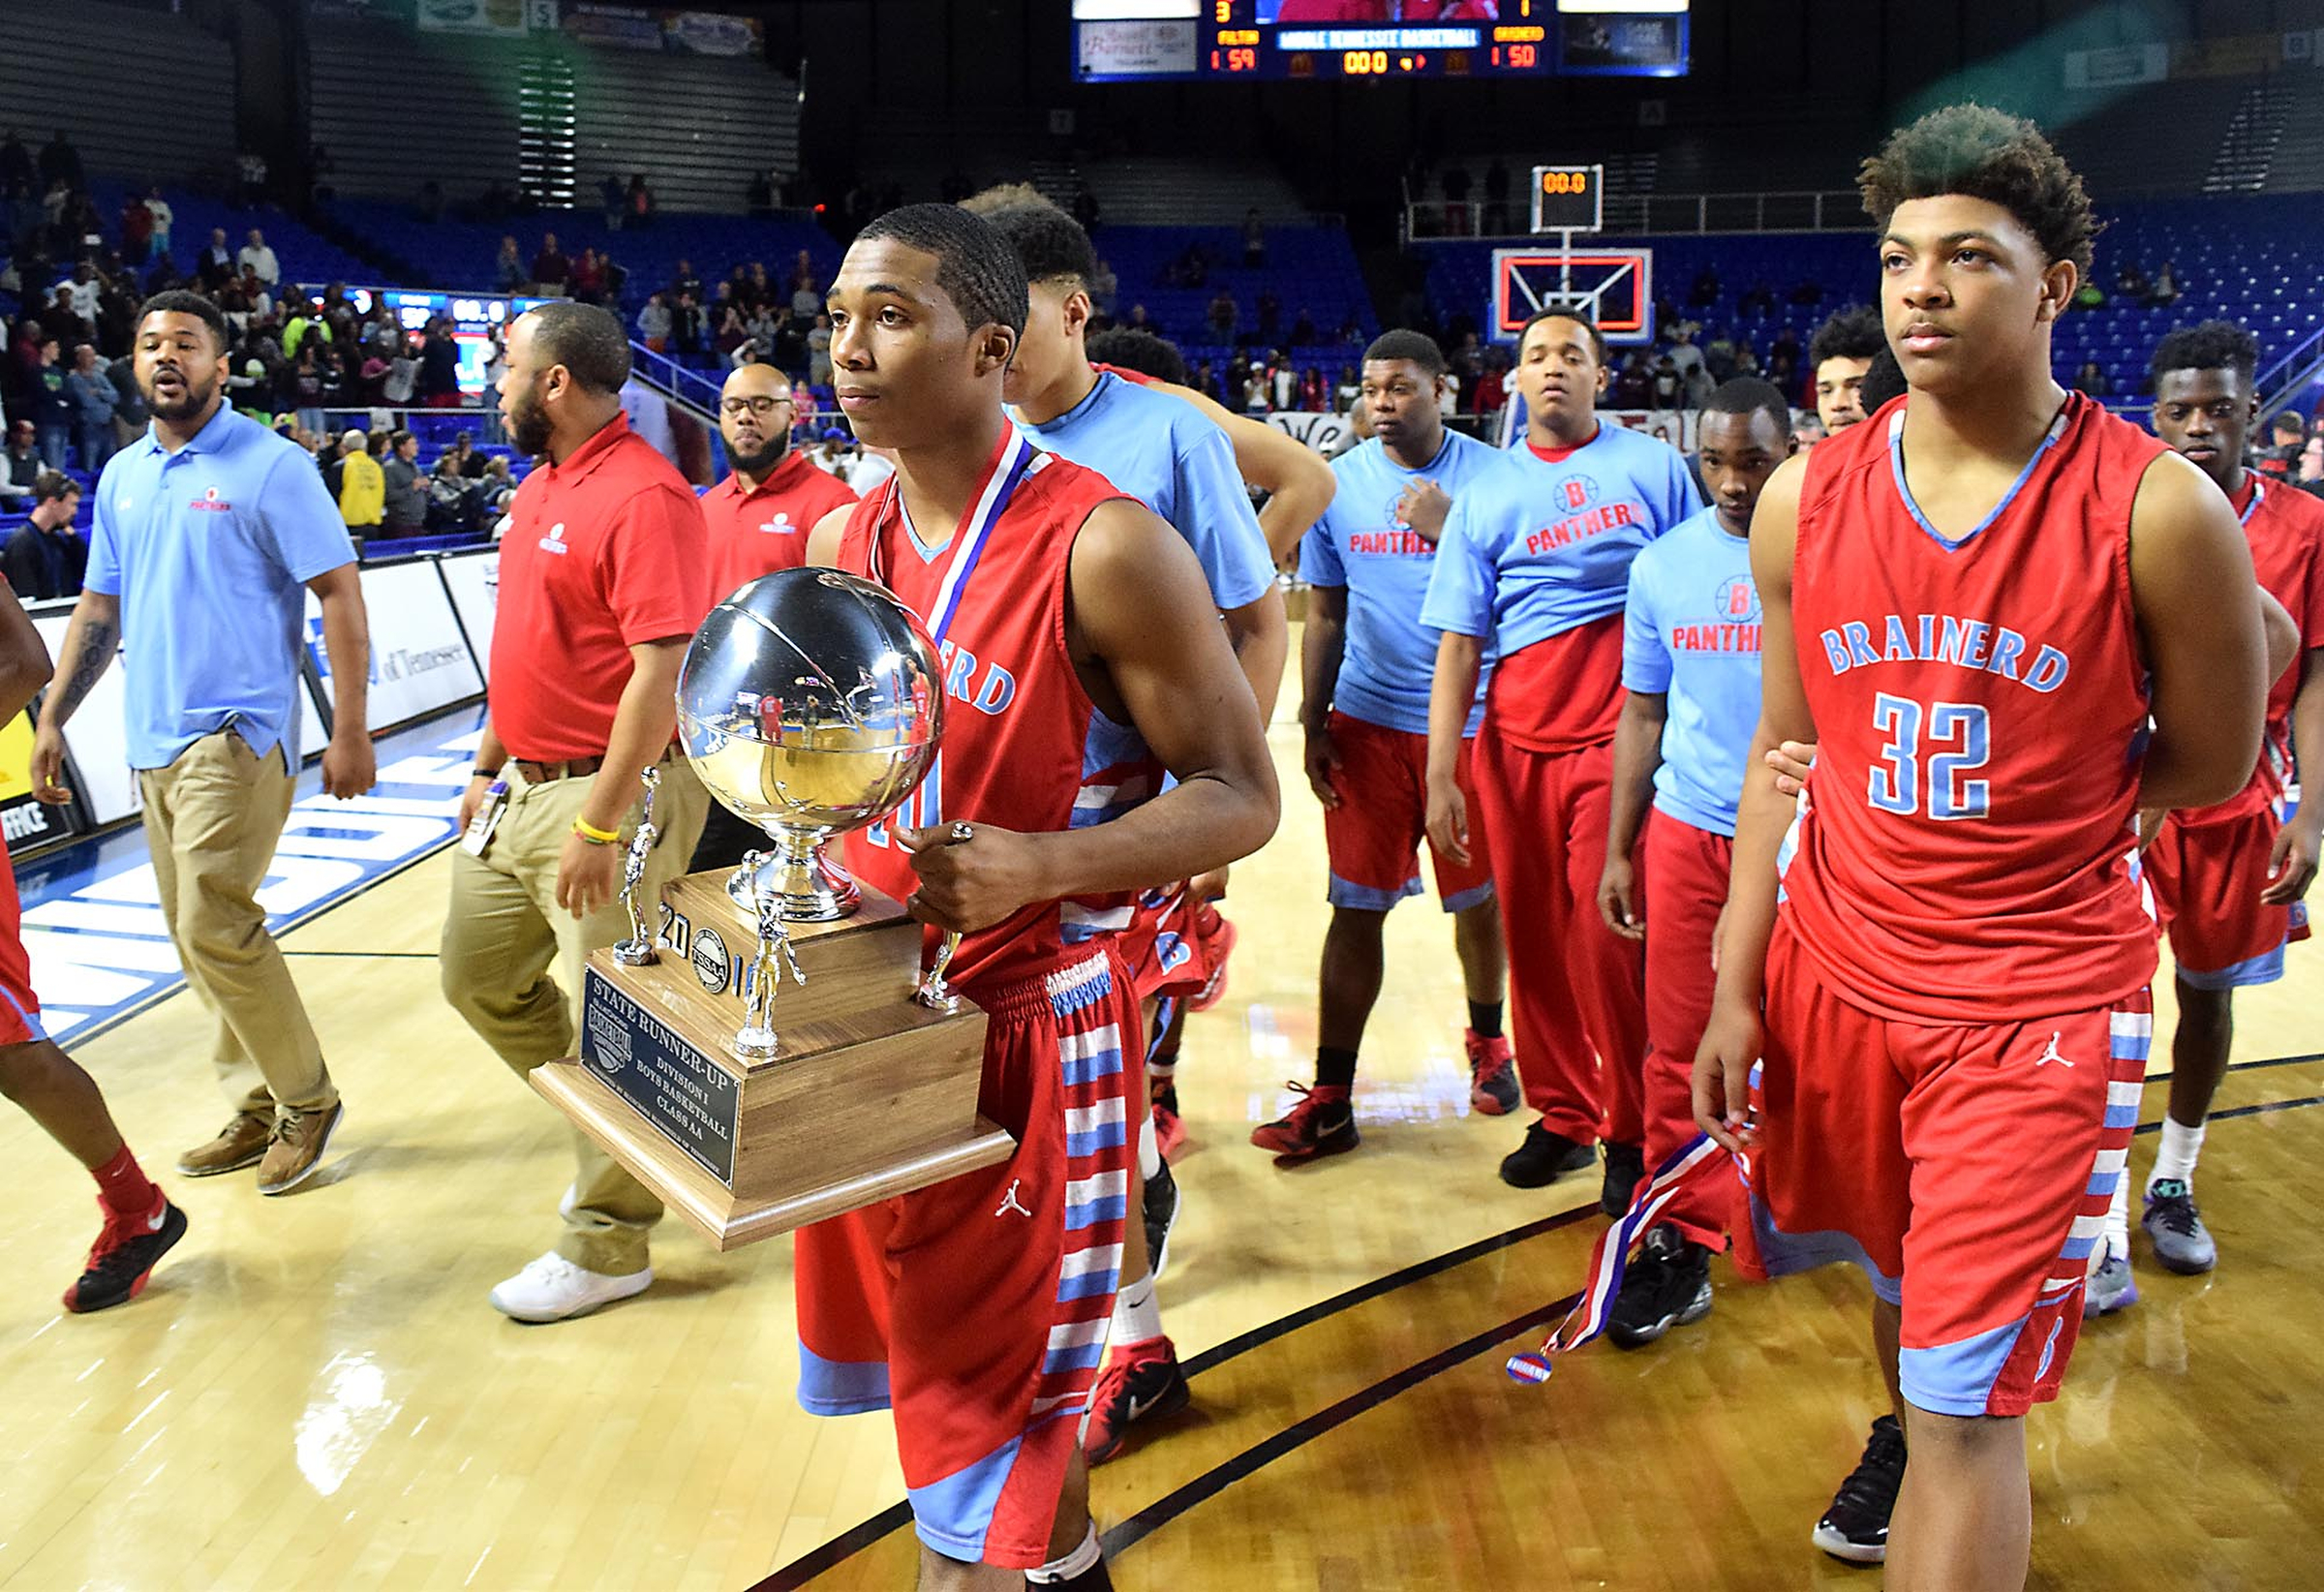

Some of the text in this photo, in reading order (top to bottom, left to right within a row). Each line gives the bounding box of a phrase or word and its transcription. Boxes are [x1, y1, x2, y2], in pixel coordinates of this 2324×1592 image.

[1329, 30, 1397, 48] TENNESSEE
[1400, 28, 1479, 47] BASKETBALL
[1508, 45, 1537, 68] 50
[1565, 481, 1586, 508] B
[1349, 532, 1437, 554] PANTHE
[1526, 503, 1645, 556] PANTHERS
[1729, 583, 1751, 614] B
[396, 644, 467, 677] Tennessee
[1672, 625, 1762, 652] PANTH
[1819, 614, 2070, 693] BRAINERD
[1867, 691, 1991, 821] 32
[656, 901, 690, 959] 20
[1155, 931, 1192, 976] B
[593, 975, 636, 1025] STATE
[638, 1010, 727, 1094] RUNNER-UP
[636, 1057, 727, 1141] BOYS BASKETBALL
[657, 1055, 708, 1106] DIVISION I
[656, 1092, 702, 1141] CLASS AA
